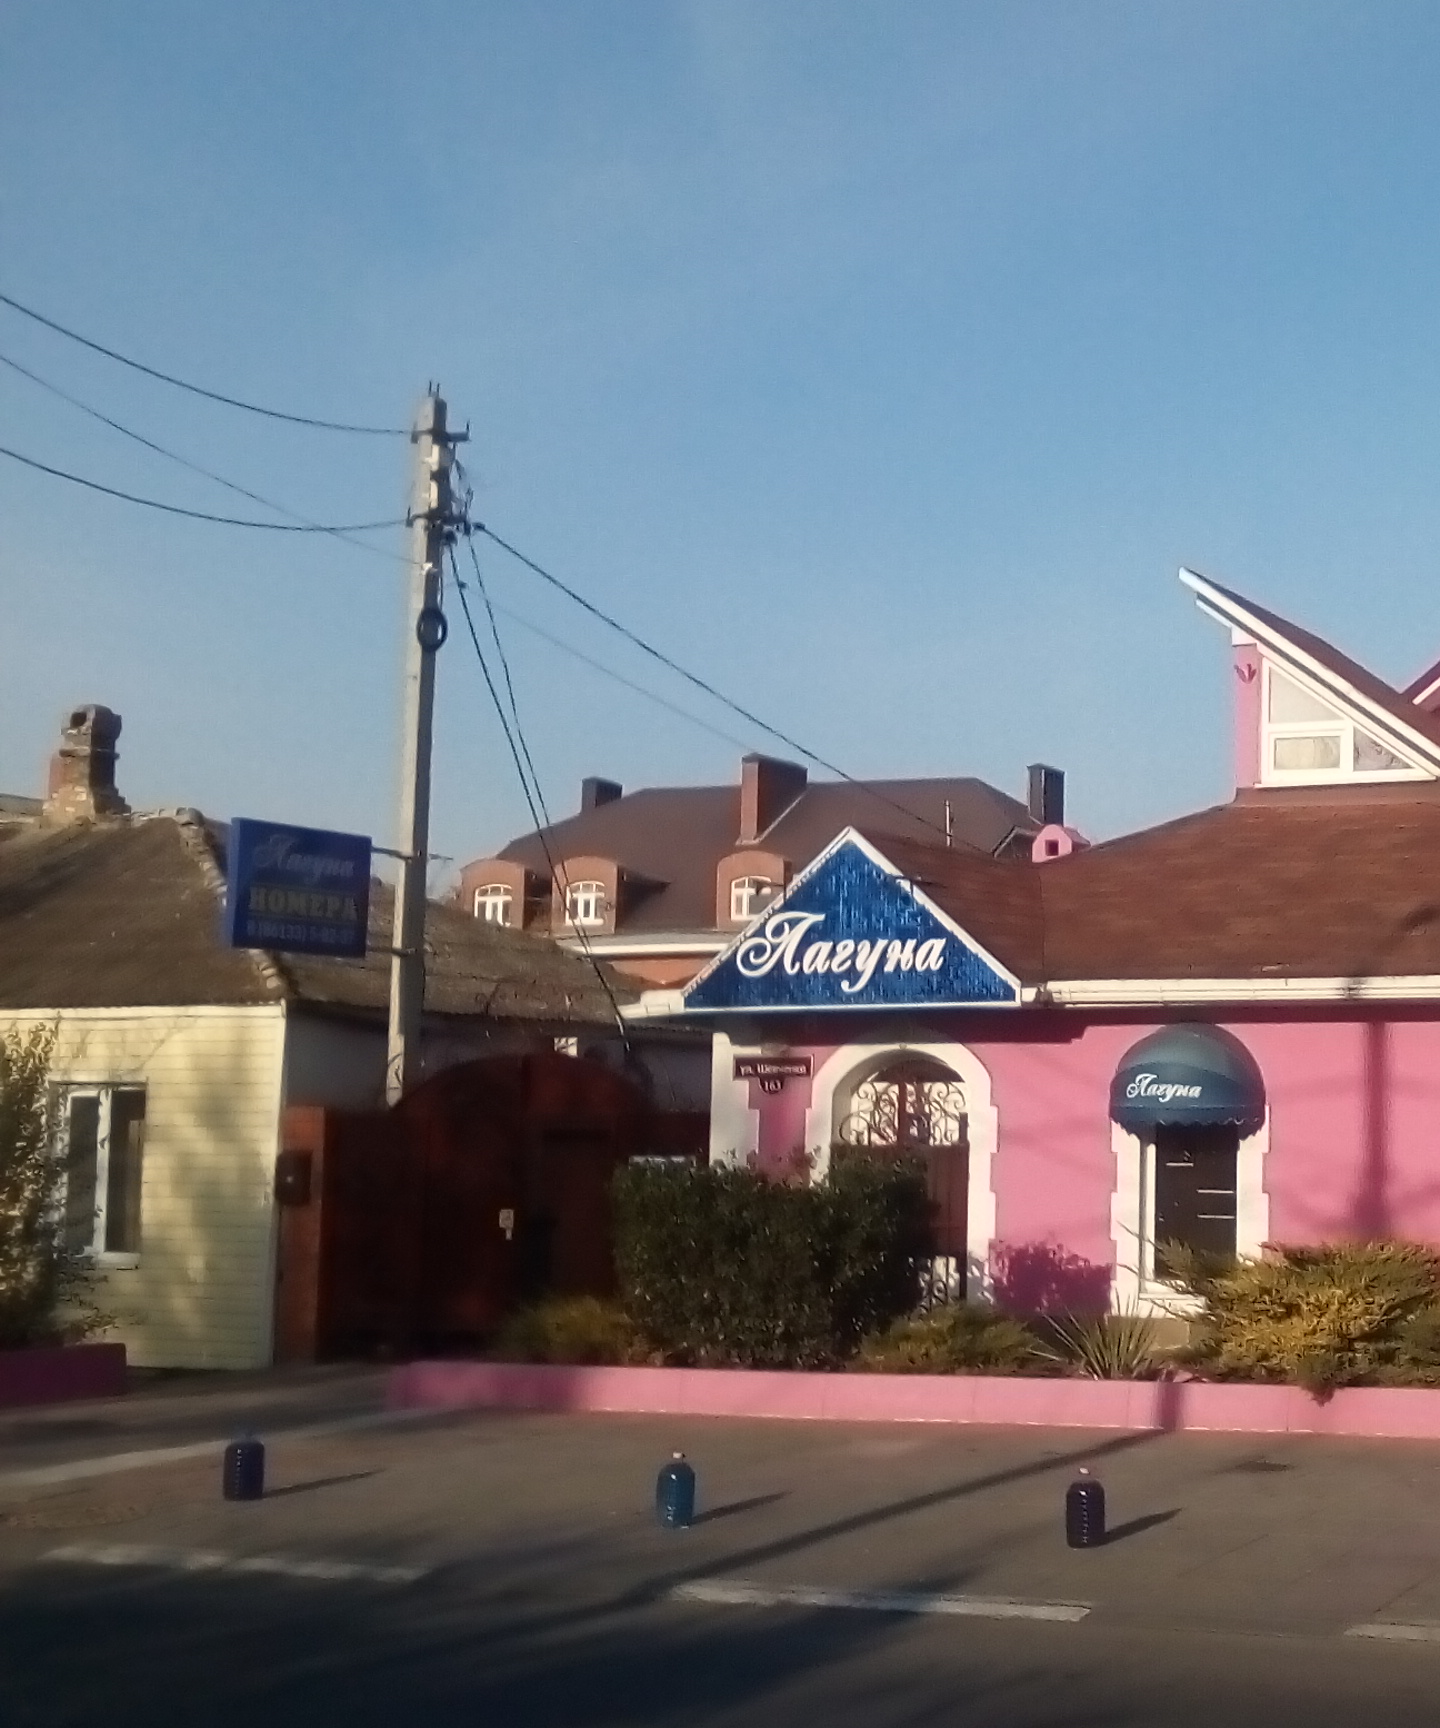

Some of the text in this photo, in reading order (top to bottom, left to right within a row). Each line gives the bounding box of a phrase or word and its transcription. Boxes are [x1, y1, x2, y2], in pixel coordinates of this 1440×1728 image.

[252, 833, 354, 885] Лагуна
[248, 887, 357, 921] НОМЕРА
[736, 911, 946, 993] Лагуна
[1126, 1073, 1202, 1103] Лагуна
